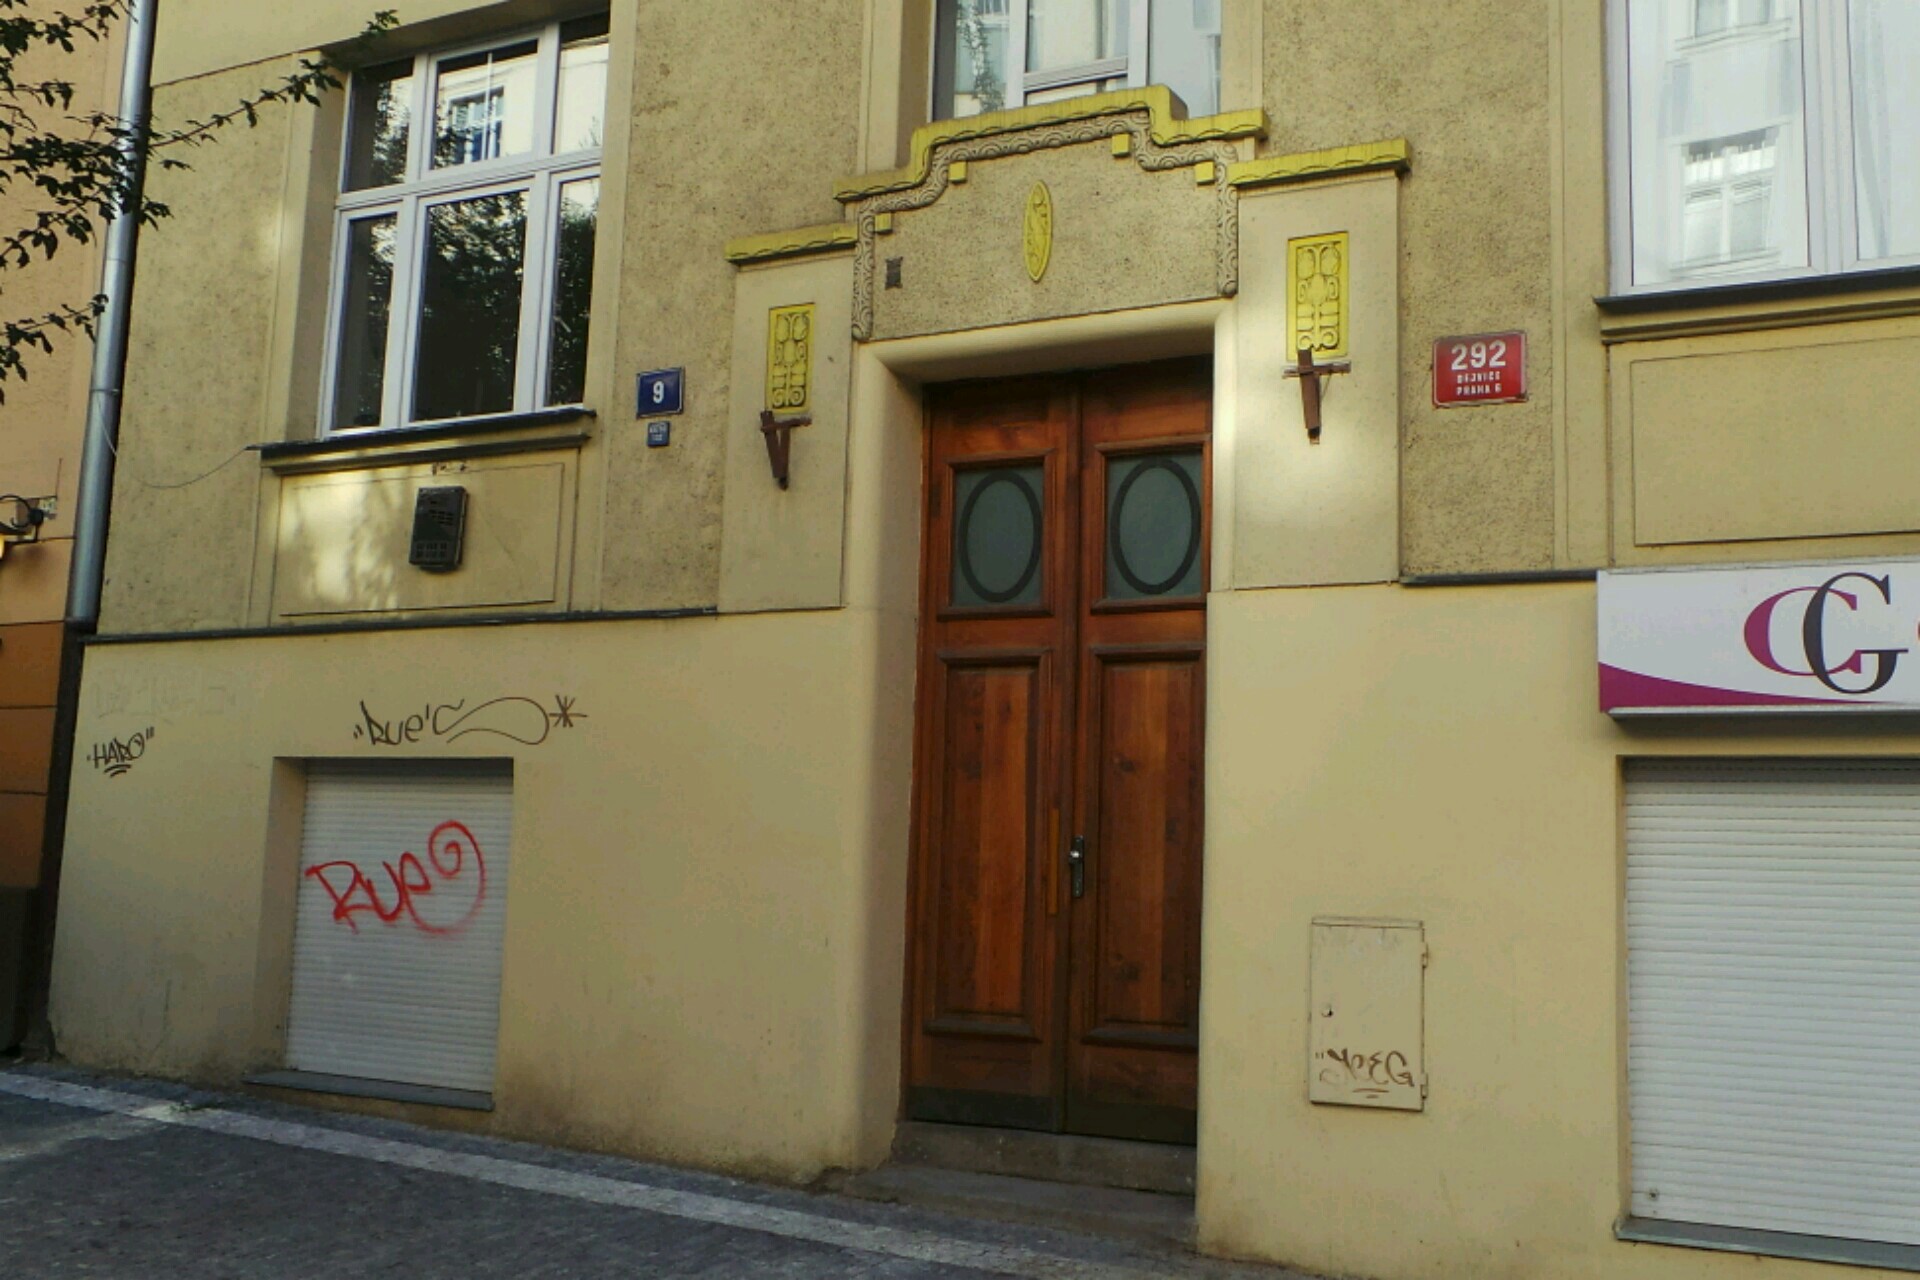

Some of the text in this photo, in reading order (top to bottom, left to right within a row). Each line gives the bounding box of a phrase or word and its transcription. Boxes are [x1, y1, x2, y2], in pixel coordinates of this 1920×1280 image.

[1451, 339, 1506, 371] 292
[652, 380, 665, 404] 9
[1456, 384, 1491, 396] PRAHA
